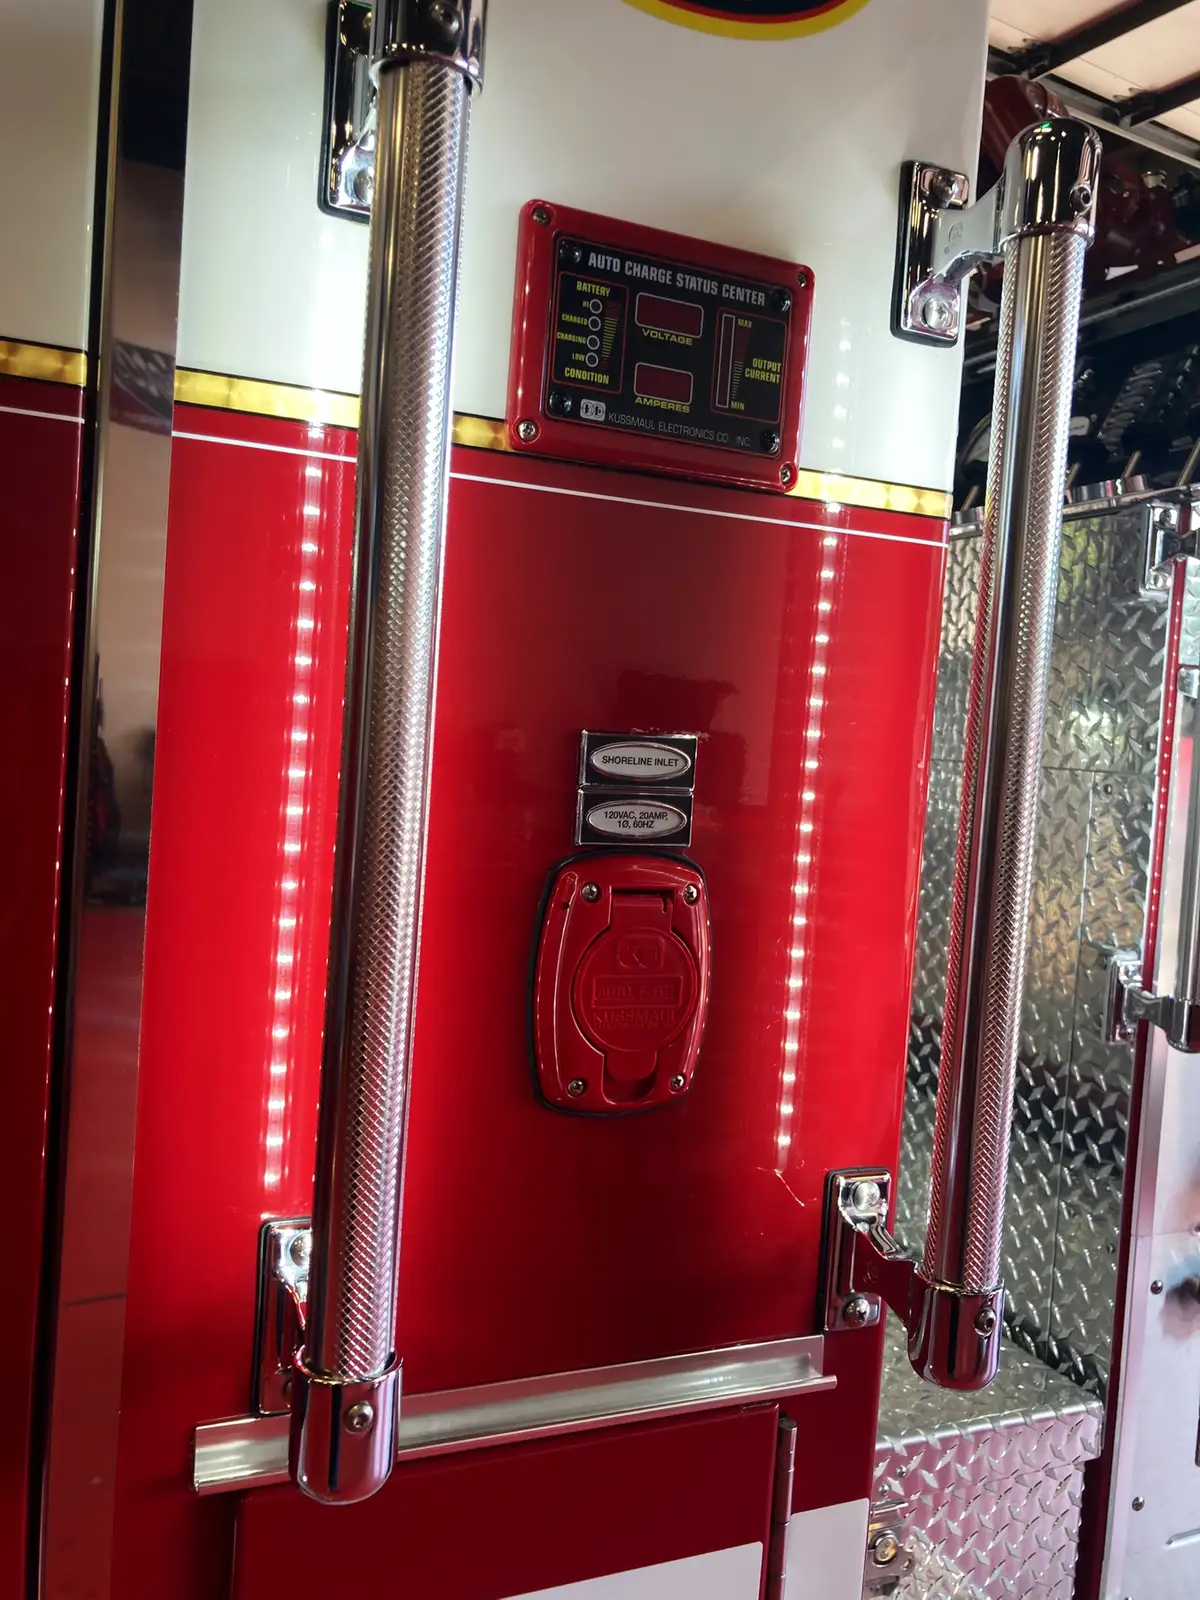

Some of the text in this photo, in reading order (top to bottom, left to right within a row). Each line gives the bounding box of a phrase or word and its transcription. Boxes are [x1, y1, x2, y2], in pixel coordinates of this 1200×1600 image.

[588, 251, 766, 307] AUTO CHARGE STATUS CENTER
[576, 280, 611, 298] BATTERY
[561, 313, 588, 326] CHARGED
[737, 318, 752, 329] MAX
[556, 331, 587, 345] CHARGING
[642, 328, 693, 346] VOLTAGE
[572, 352, 585, 362] LOW
[752, 357, 782, 373] OUTPUT
[564, 367, 610, 385] CONDITION
[744, 367, 780, 384] CURRENT
[634, 396, 691, 414] AMPERES
[730, 400, 745, 411] MIN
[608, 412, 656, 431] KUSSMAUL
[658, 420, 715, 441] ELECTRONICS
[601, 755, 680, 767] SHORELINE INLET
[604, 810, 669, 822] 120VAC, 20AMP,
[632, 820, 655, 829] 60HZ
